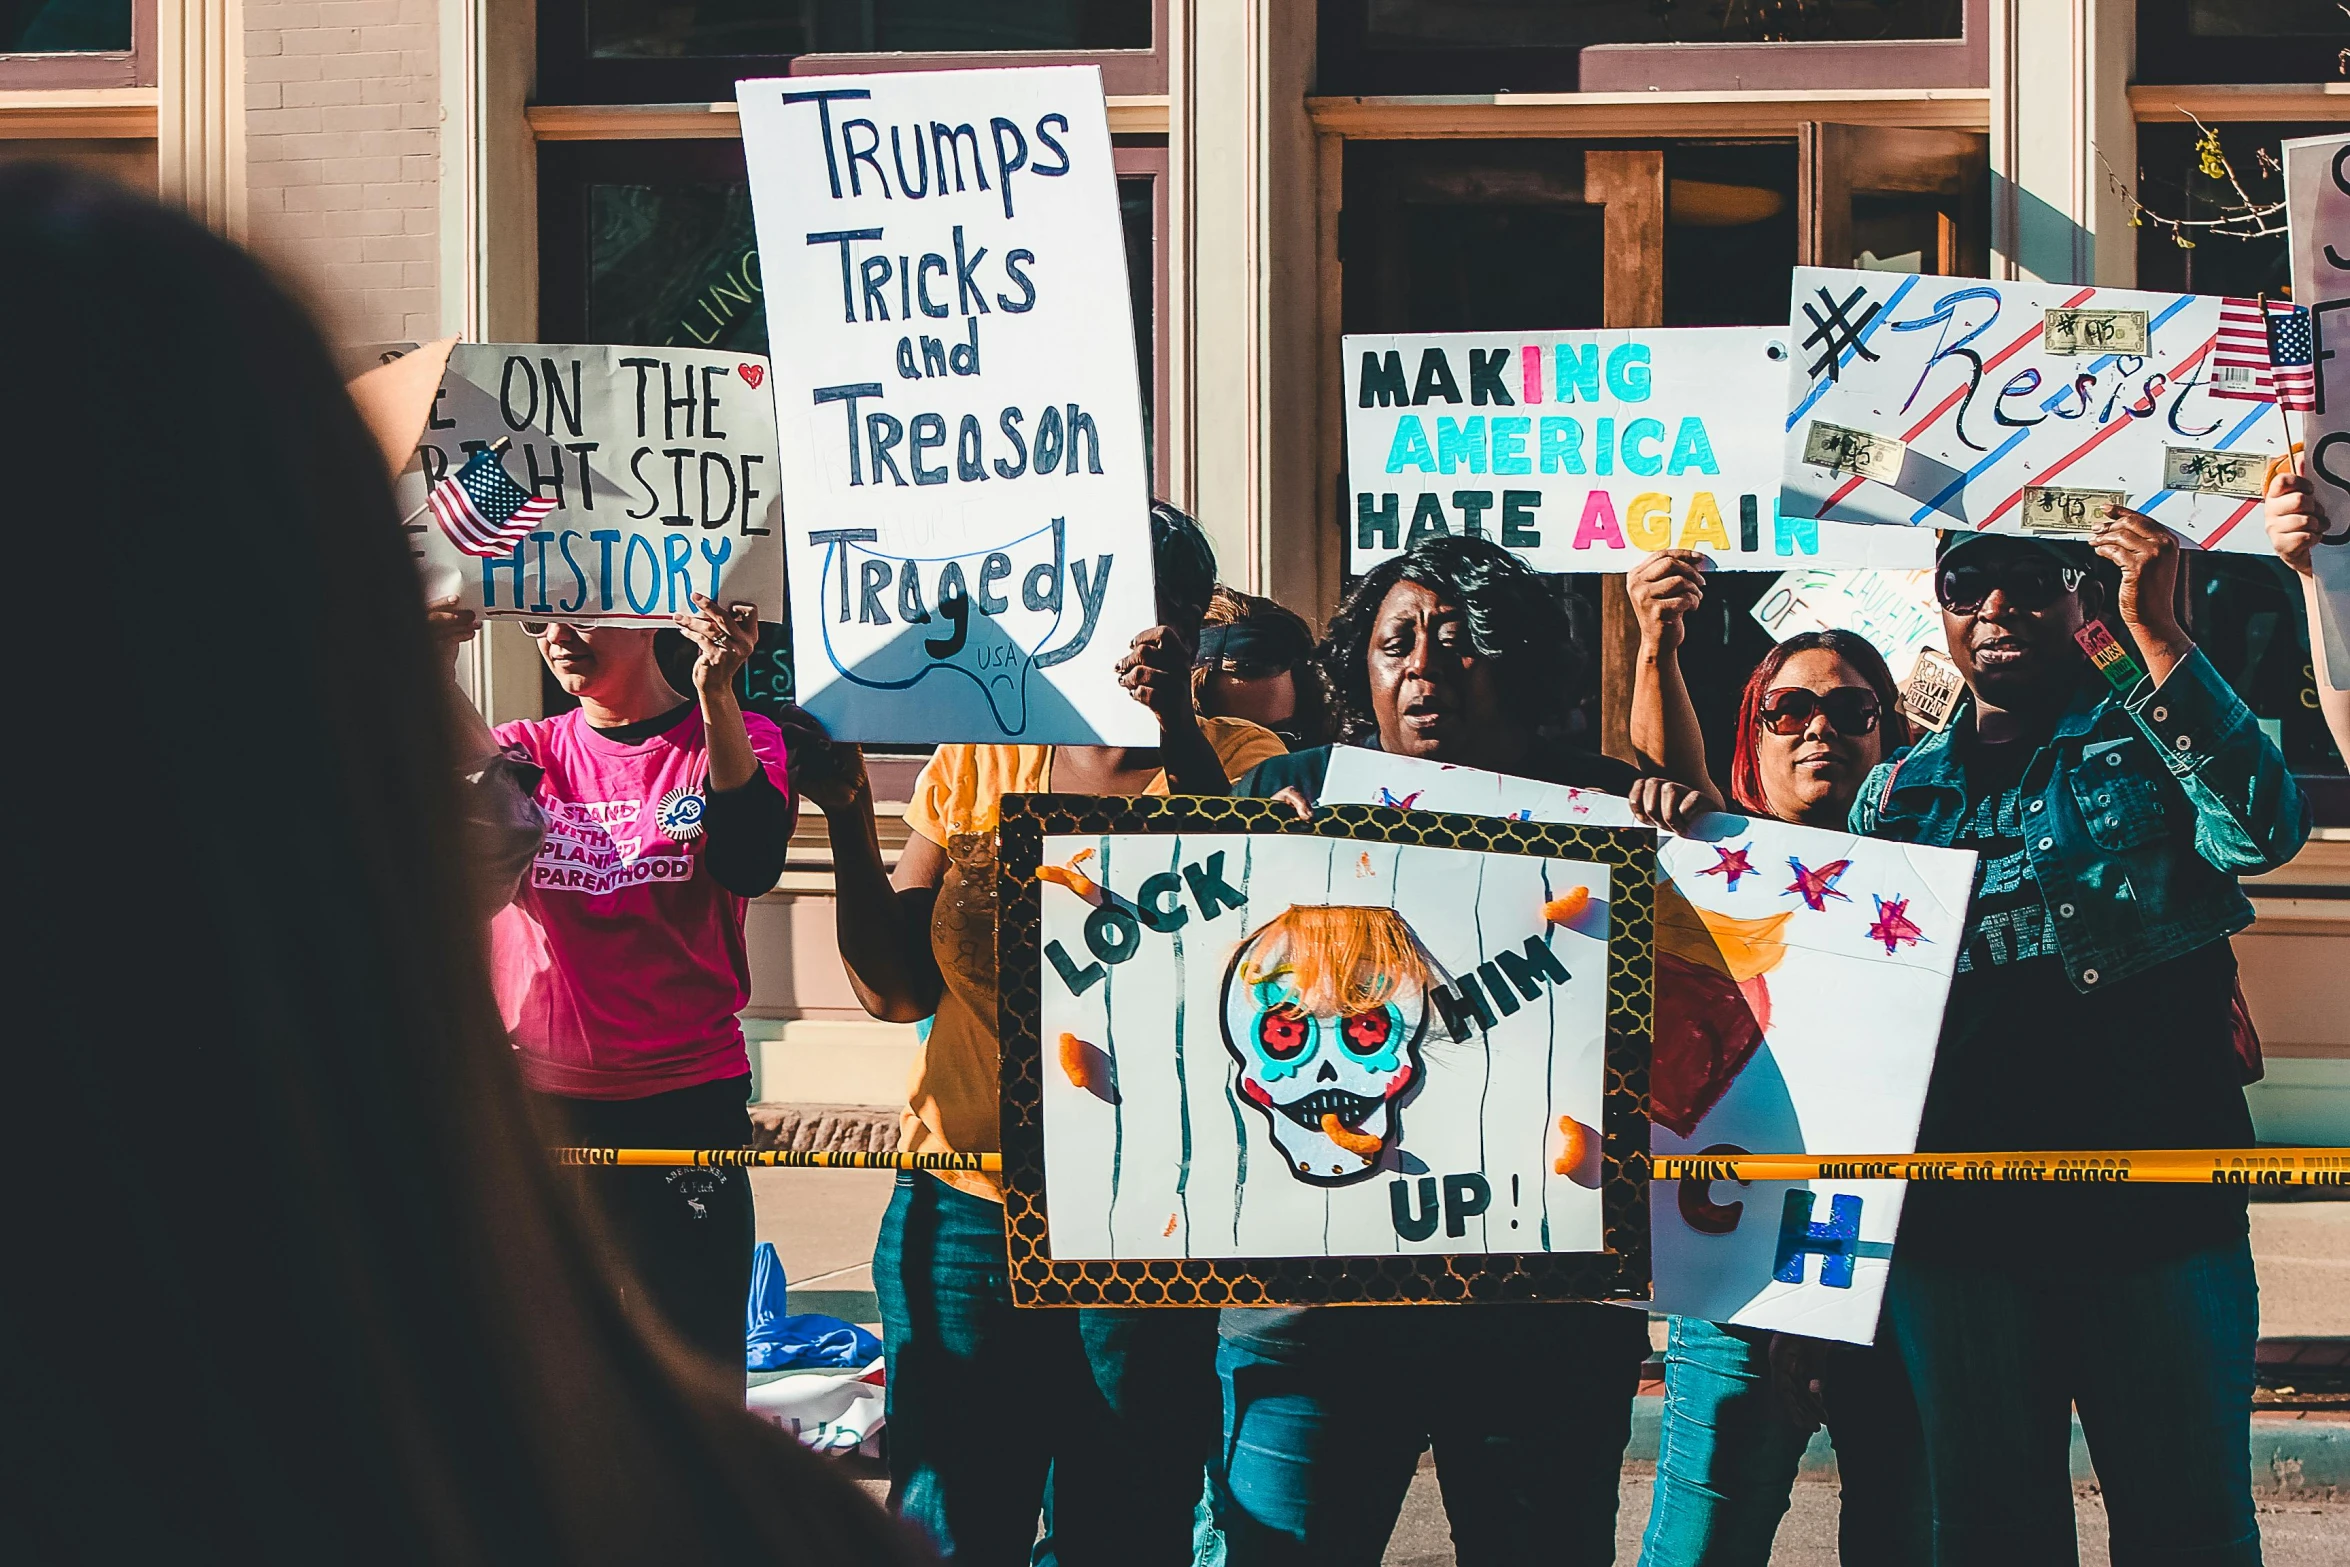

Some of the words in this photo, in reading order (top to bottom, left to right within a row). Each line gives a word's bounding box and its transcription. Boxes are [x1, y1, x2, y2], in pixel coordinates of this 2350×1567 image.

[896, 317, 981, 380] and
[1358, 343, 1652, 408] MAKING
[501, 355, 582, 437] ON
[619, 357, 729, 440] THE
[1385, 415, 1720, 476] AMERICA
[626, 447, 771, 537] SIDE
[1357, 490, 1542, 550] HATE
[1571, 490, 1819, 556] AGAIN
[483, 530, 731, 615] HISTORY
[1760, 588, 1810, 631] OF
[1843, 568, 1939, 655] LAUGHING
[977, 642, 1018, 668] USA
[2096, 644, 2121, 666] LIVES
[548, 819, 611, 848] WITH
[562, 803, 637, 824] STAND
[535, 859, 688, 892] PARENTHOOD
[1044, 850, 1248, 996] LOCK
[1429, 934, 1571, 1044] HIM
